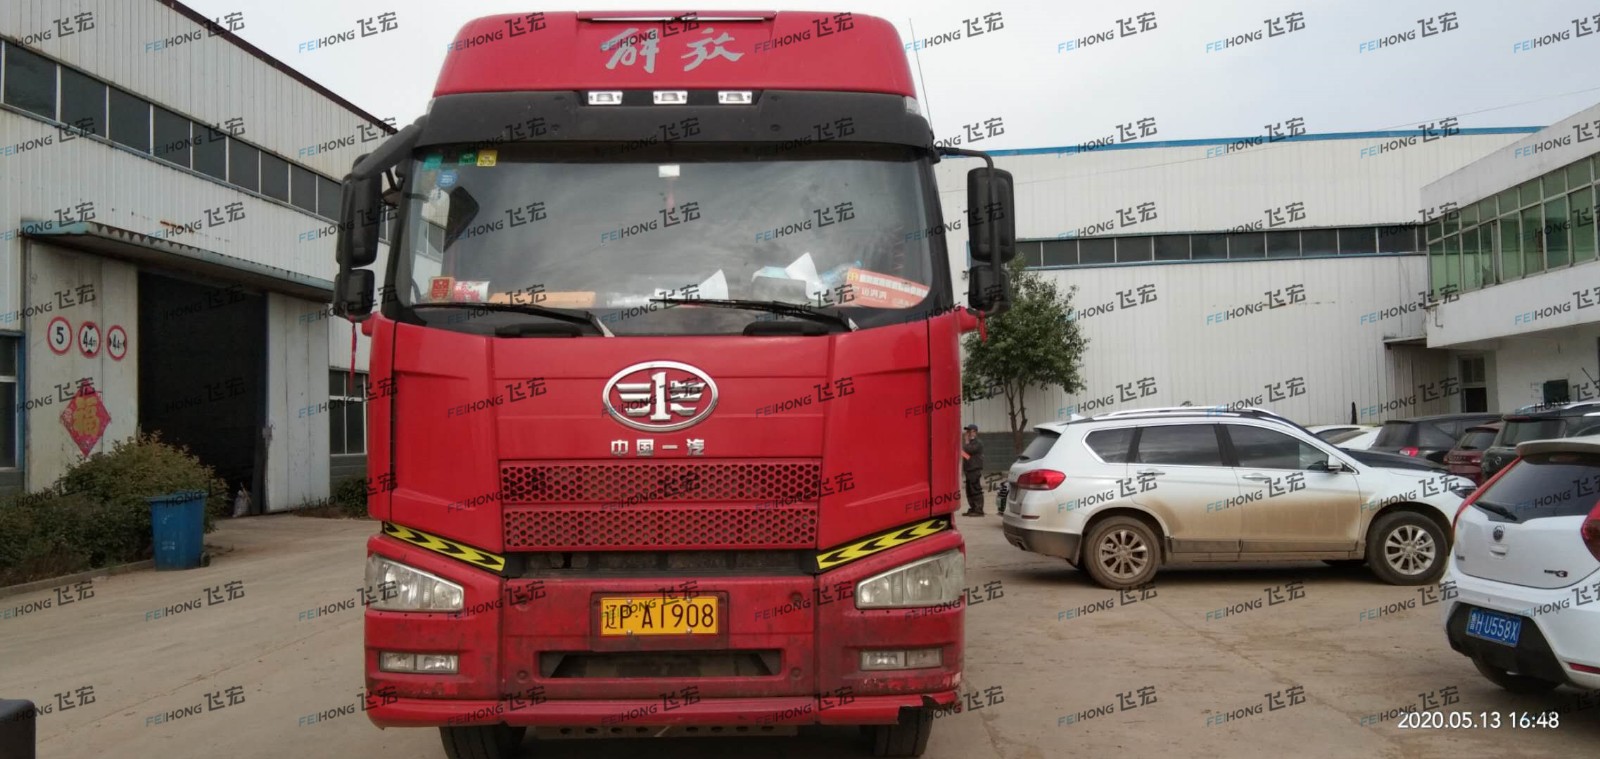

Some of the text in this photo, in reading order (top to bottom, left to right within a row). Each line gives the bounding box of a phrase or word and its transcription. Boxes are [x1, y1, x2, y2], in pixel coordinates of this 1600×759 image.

[600, 28, 745, 73] 解放
[56, 326, 65, 345] 5
[611, 439, 704, 456] 中国一汽
